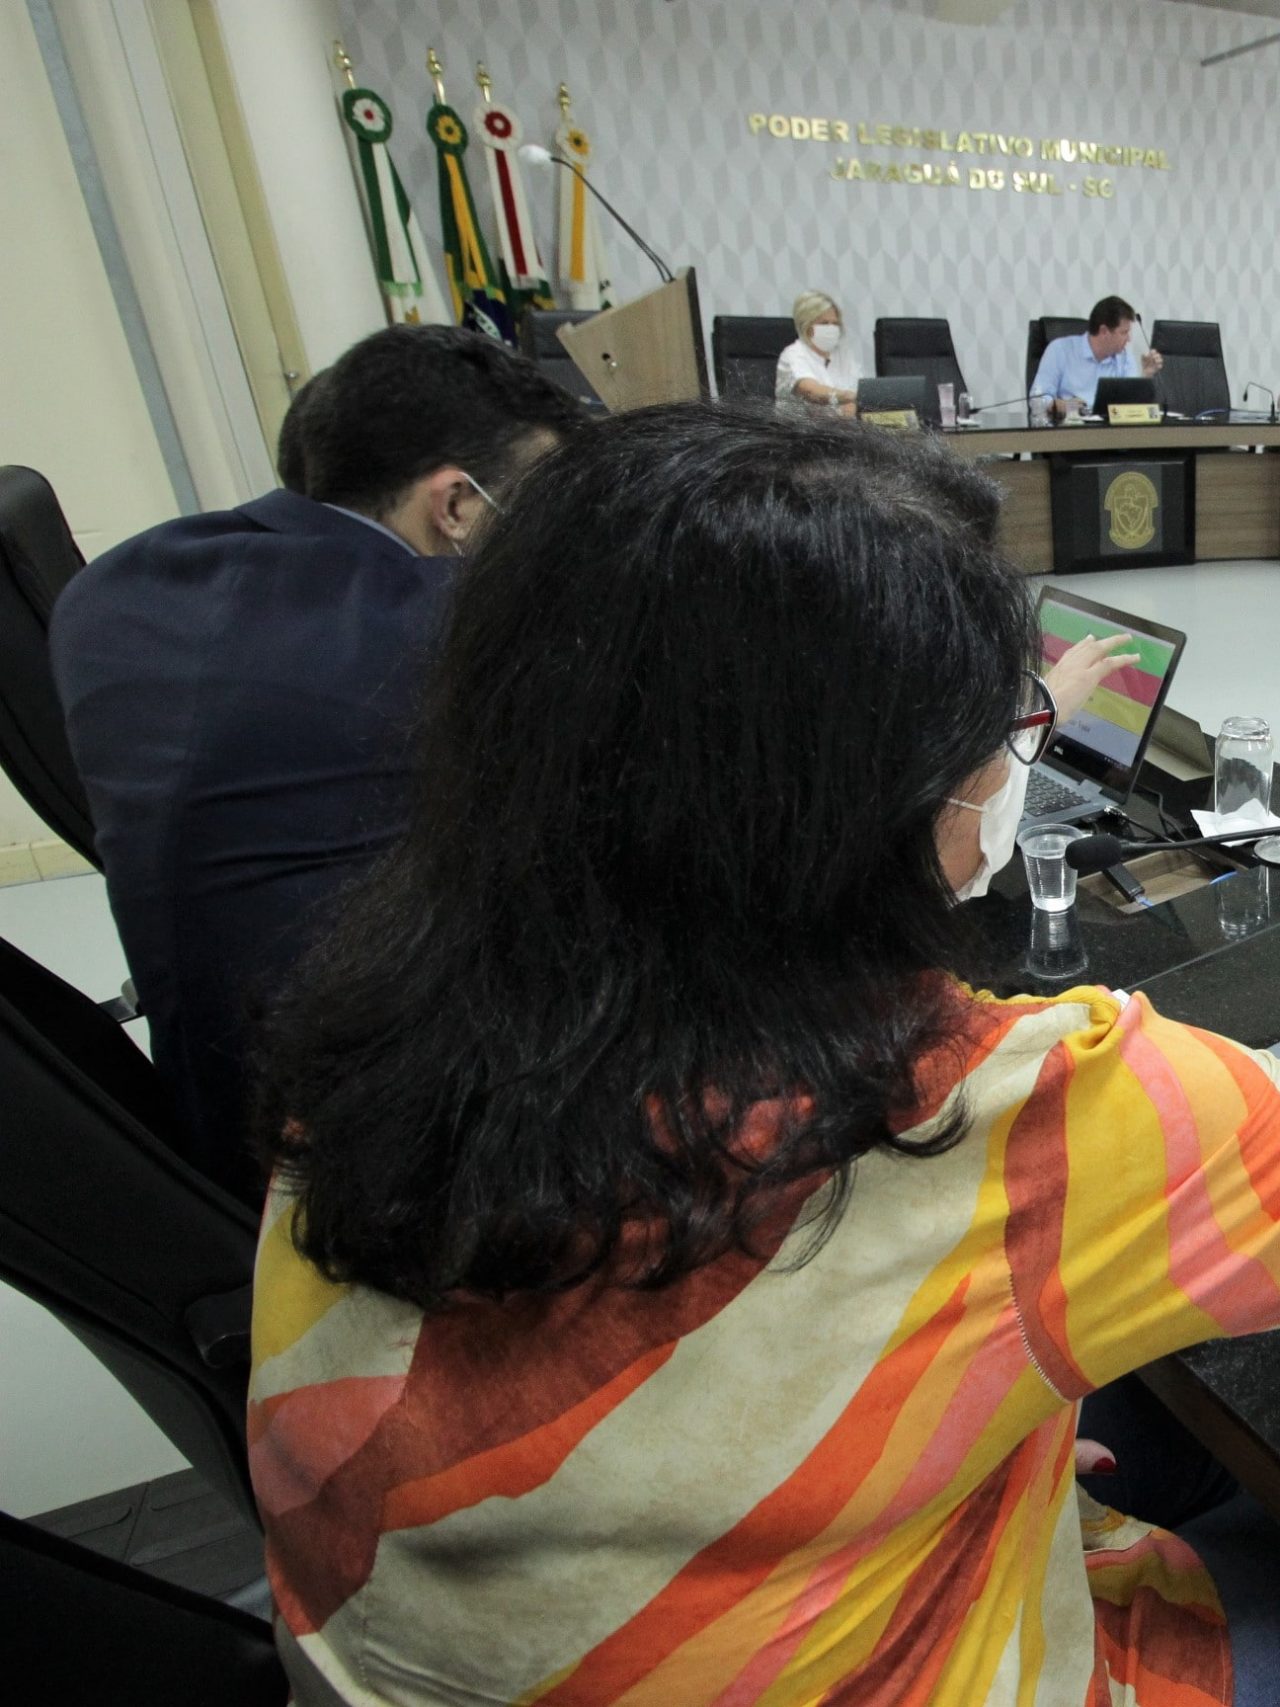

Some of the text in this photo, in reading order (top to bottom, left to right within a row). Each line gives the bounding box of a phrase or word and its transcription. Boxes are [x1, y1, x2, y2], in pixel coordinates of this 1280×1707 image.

[748, 113, 1171, 169] PODER LEGISLATIVO MUNICIPAL
[831, 156, 961, 186] JARAGUÁ
[969, 168, 1005, 190] DO
[1012, 171, 1063, 195] SUL
[1082, 175, 1114, 199] SC
